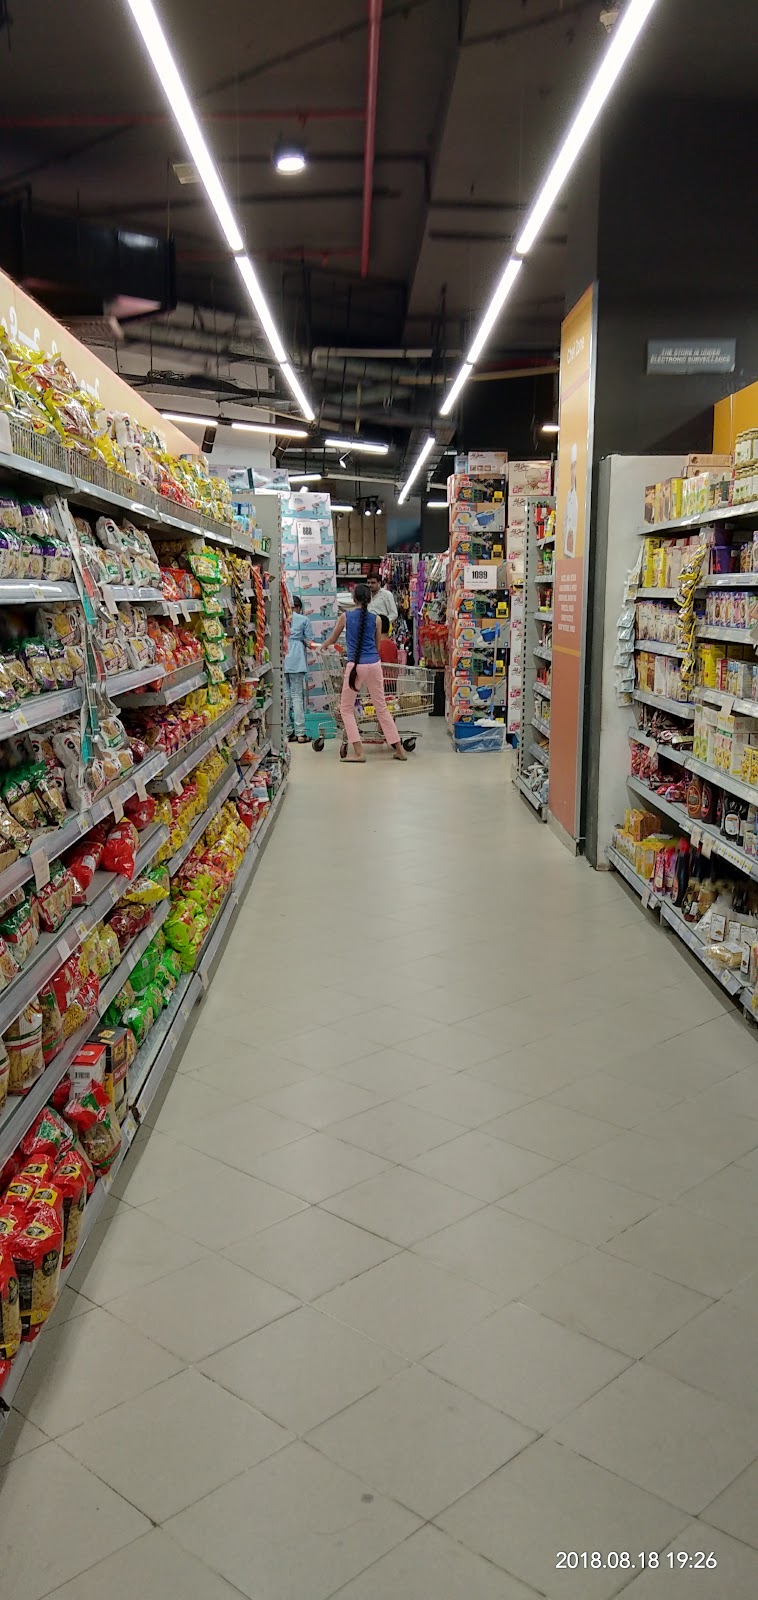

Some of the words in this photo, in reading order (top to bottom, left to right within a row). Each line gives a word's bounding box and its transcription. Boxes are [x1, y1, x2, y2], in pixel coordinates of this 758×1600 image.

[650, 355, 687, 364] ELECTRONIC
[687, 355, 731, 364] SURVEILLANCE
[302, 527, 313, 535] 888
[472, 570, 488, 580] 1099
